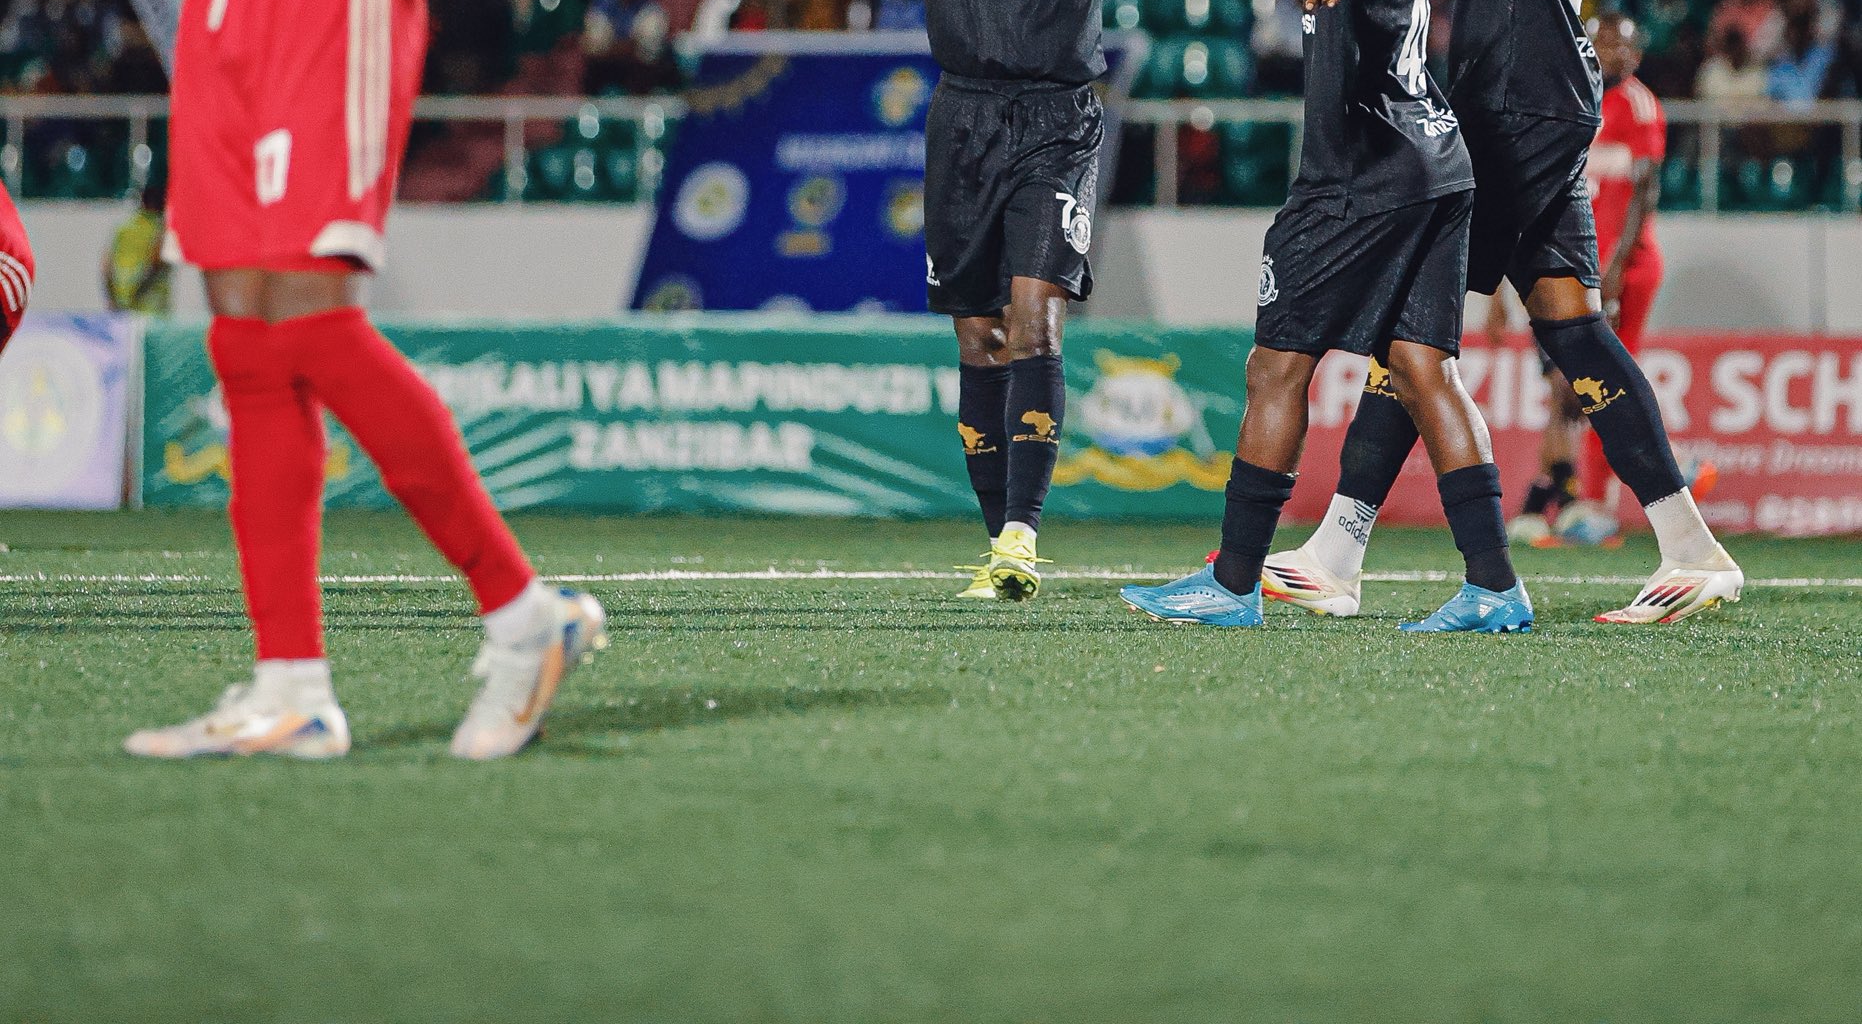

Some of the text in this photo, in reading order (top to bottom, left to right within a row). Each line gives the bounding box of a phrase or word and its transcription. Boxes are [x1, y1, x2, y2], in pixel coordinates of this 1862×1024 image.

[1055, 192, 1077, 229] 7
[1709, 348, 1862, 435] SCH
[567, 420, 815, 473] ZANZIBAR
